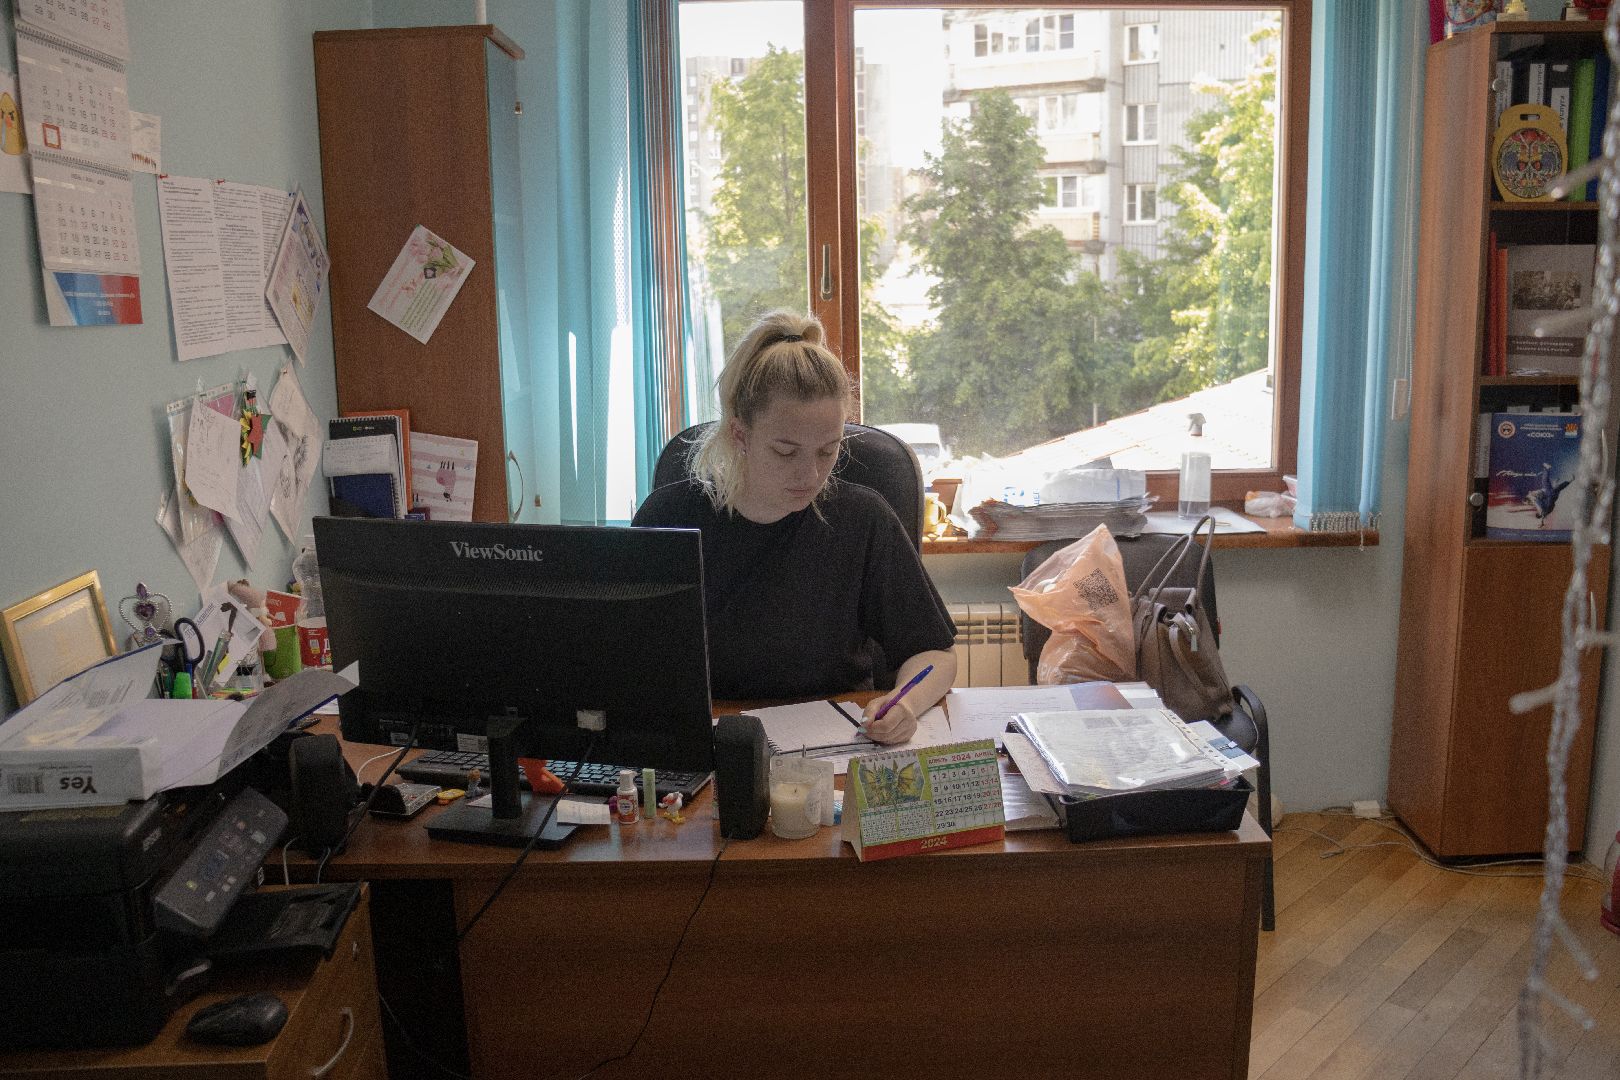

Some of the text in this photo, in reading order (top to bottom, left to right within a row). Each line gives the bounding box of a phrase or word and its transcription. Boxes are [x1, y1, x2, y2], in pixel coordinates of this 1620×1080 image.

[450, 541, 544, 562] ViewSonic
[952, 753, 971, 762] 2024
[60, 776, 98, 794] Yes
[920, 836, 948, 848] 2024
